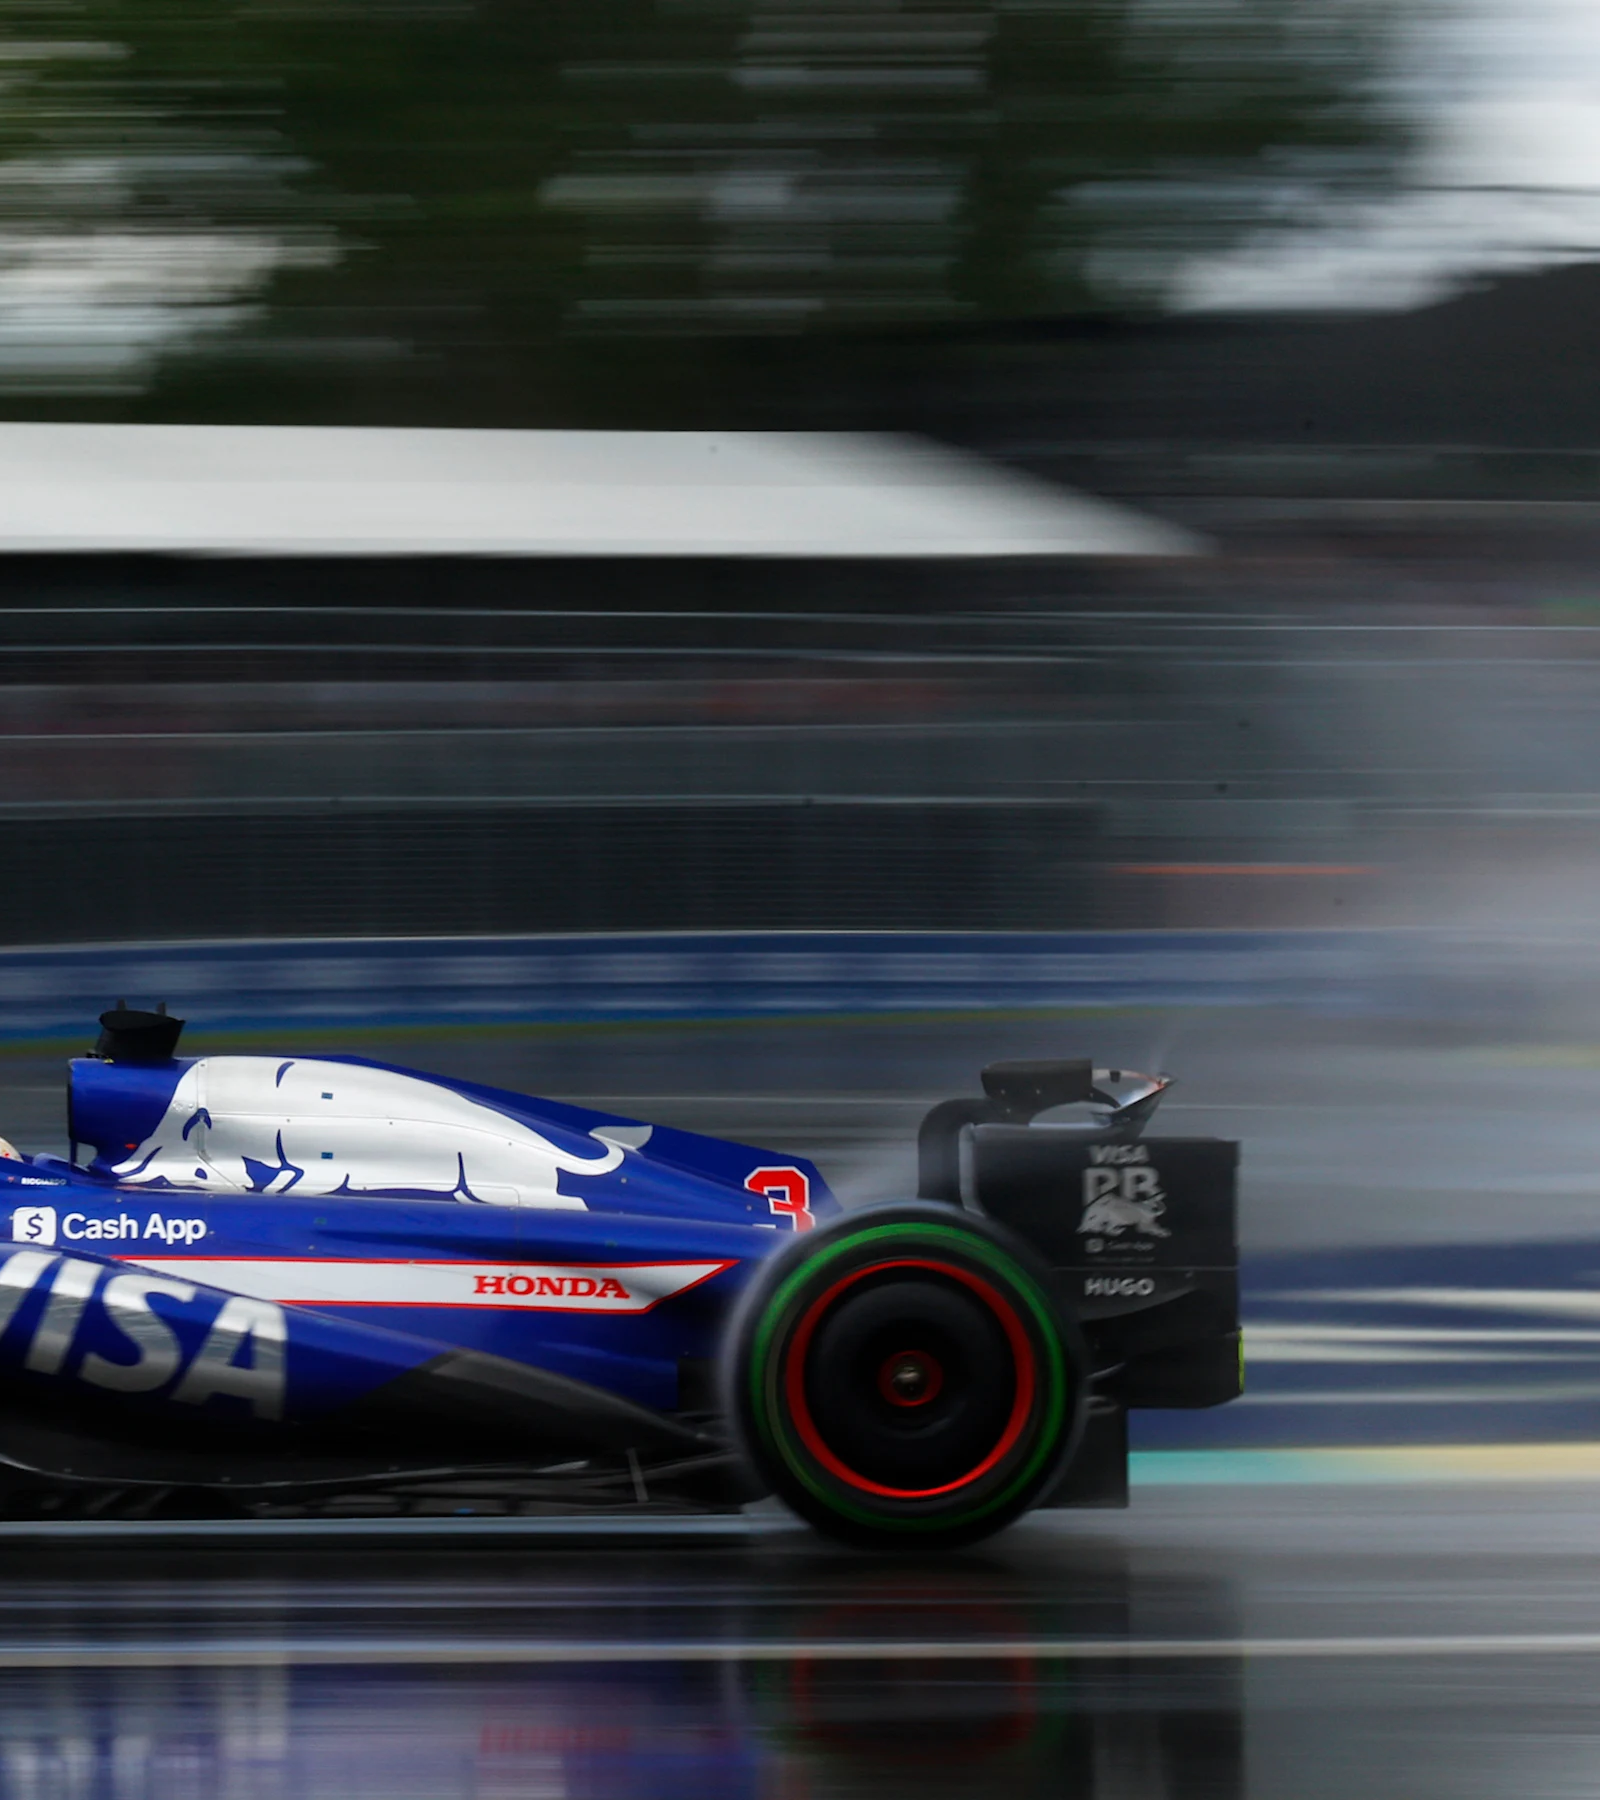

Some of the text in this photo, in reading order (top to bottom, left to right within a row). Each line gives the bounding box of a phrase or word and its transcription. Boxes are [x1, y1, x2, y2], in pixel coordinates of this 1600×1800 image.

[62, 1213, 139, 1240] Cash
[143, 1212, 207, 1246] App
[473, 1275, 631, 1299] HONDA
[1084, 1277, 1155, 1297] HUGO
